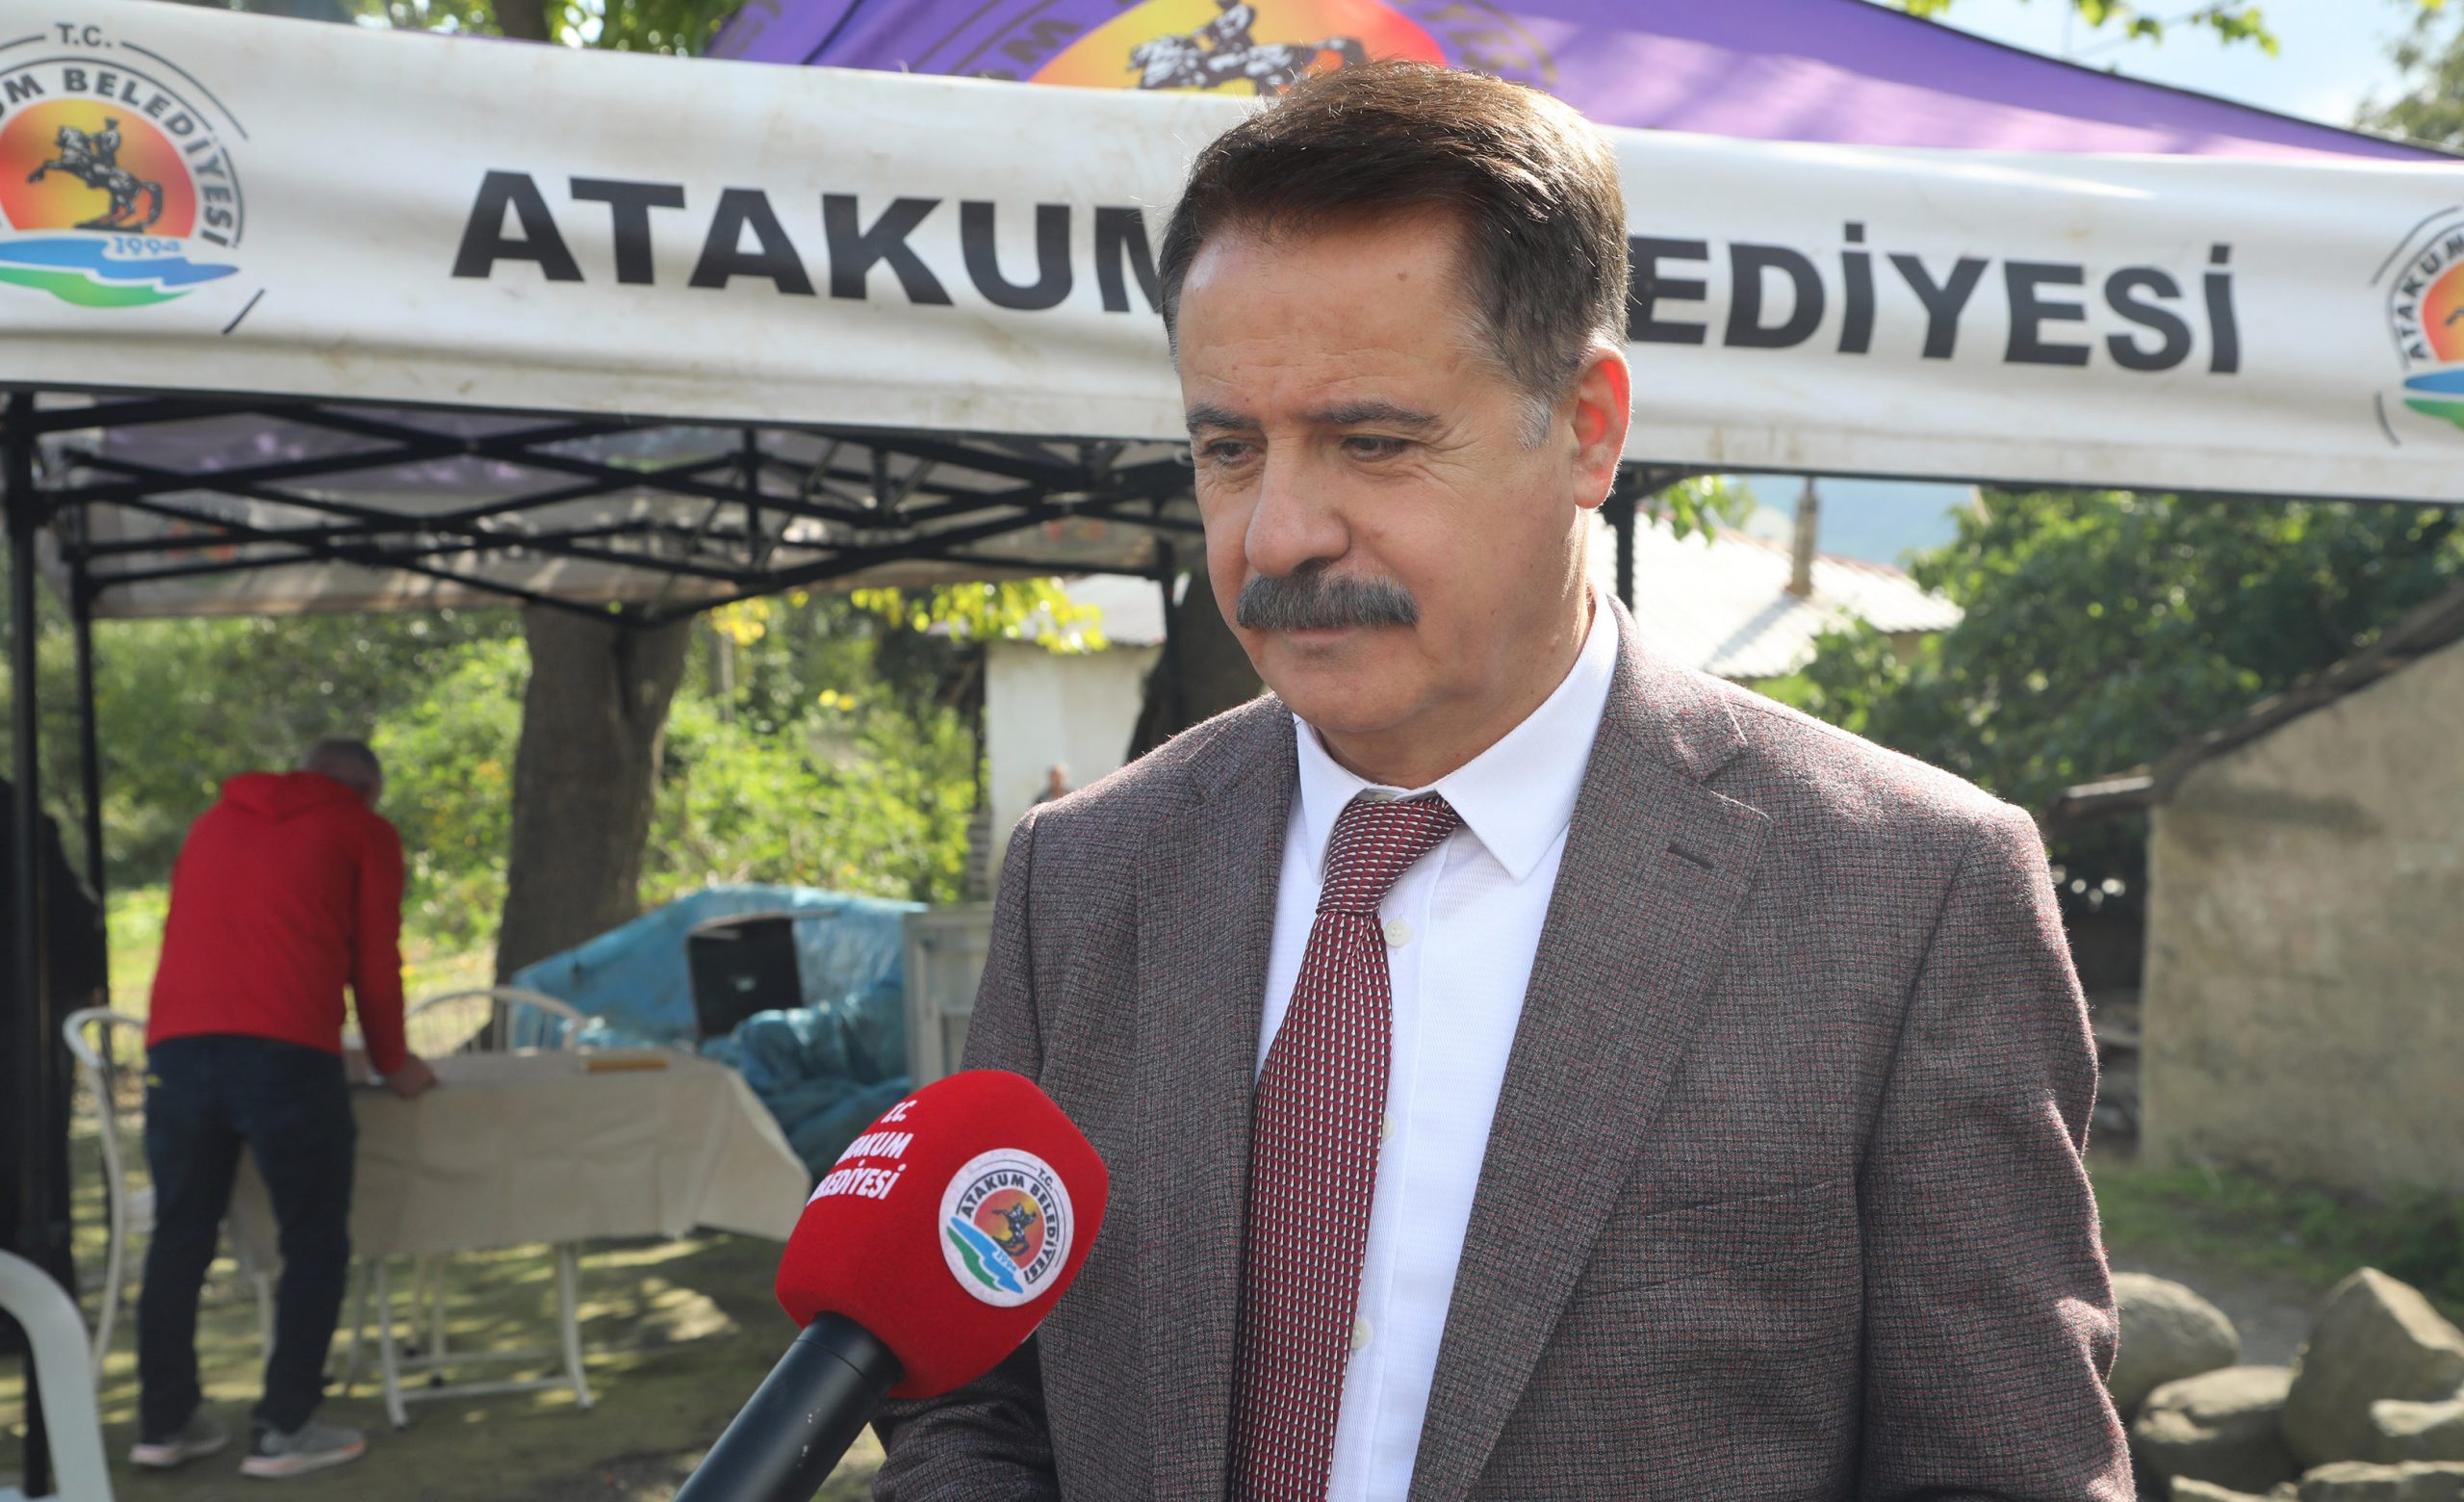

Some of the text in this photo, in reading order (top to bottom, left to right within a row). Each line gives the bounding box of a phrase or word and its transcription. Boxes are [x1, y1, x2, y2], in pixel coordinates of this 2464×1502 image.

[56, 22, 113, 48] T.C.
[1625, 220, 2240, 375] EDİYESİ
[961, 1174, 1024, 1219] ATAKUM
[1039, 1168, 1054, 1190] T.C.
